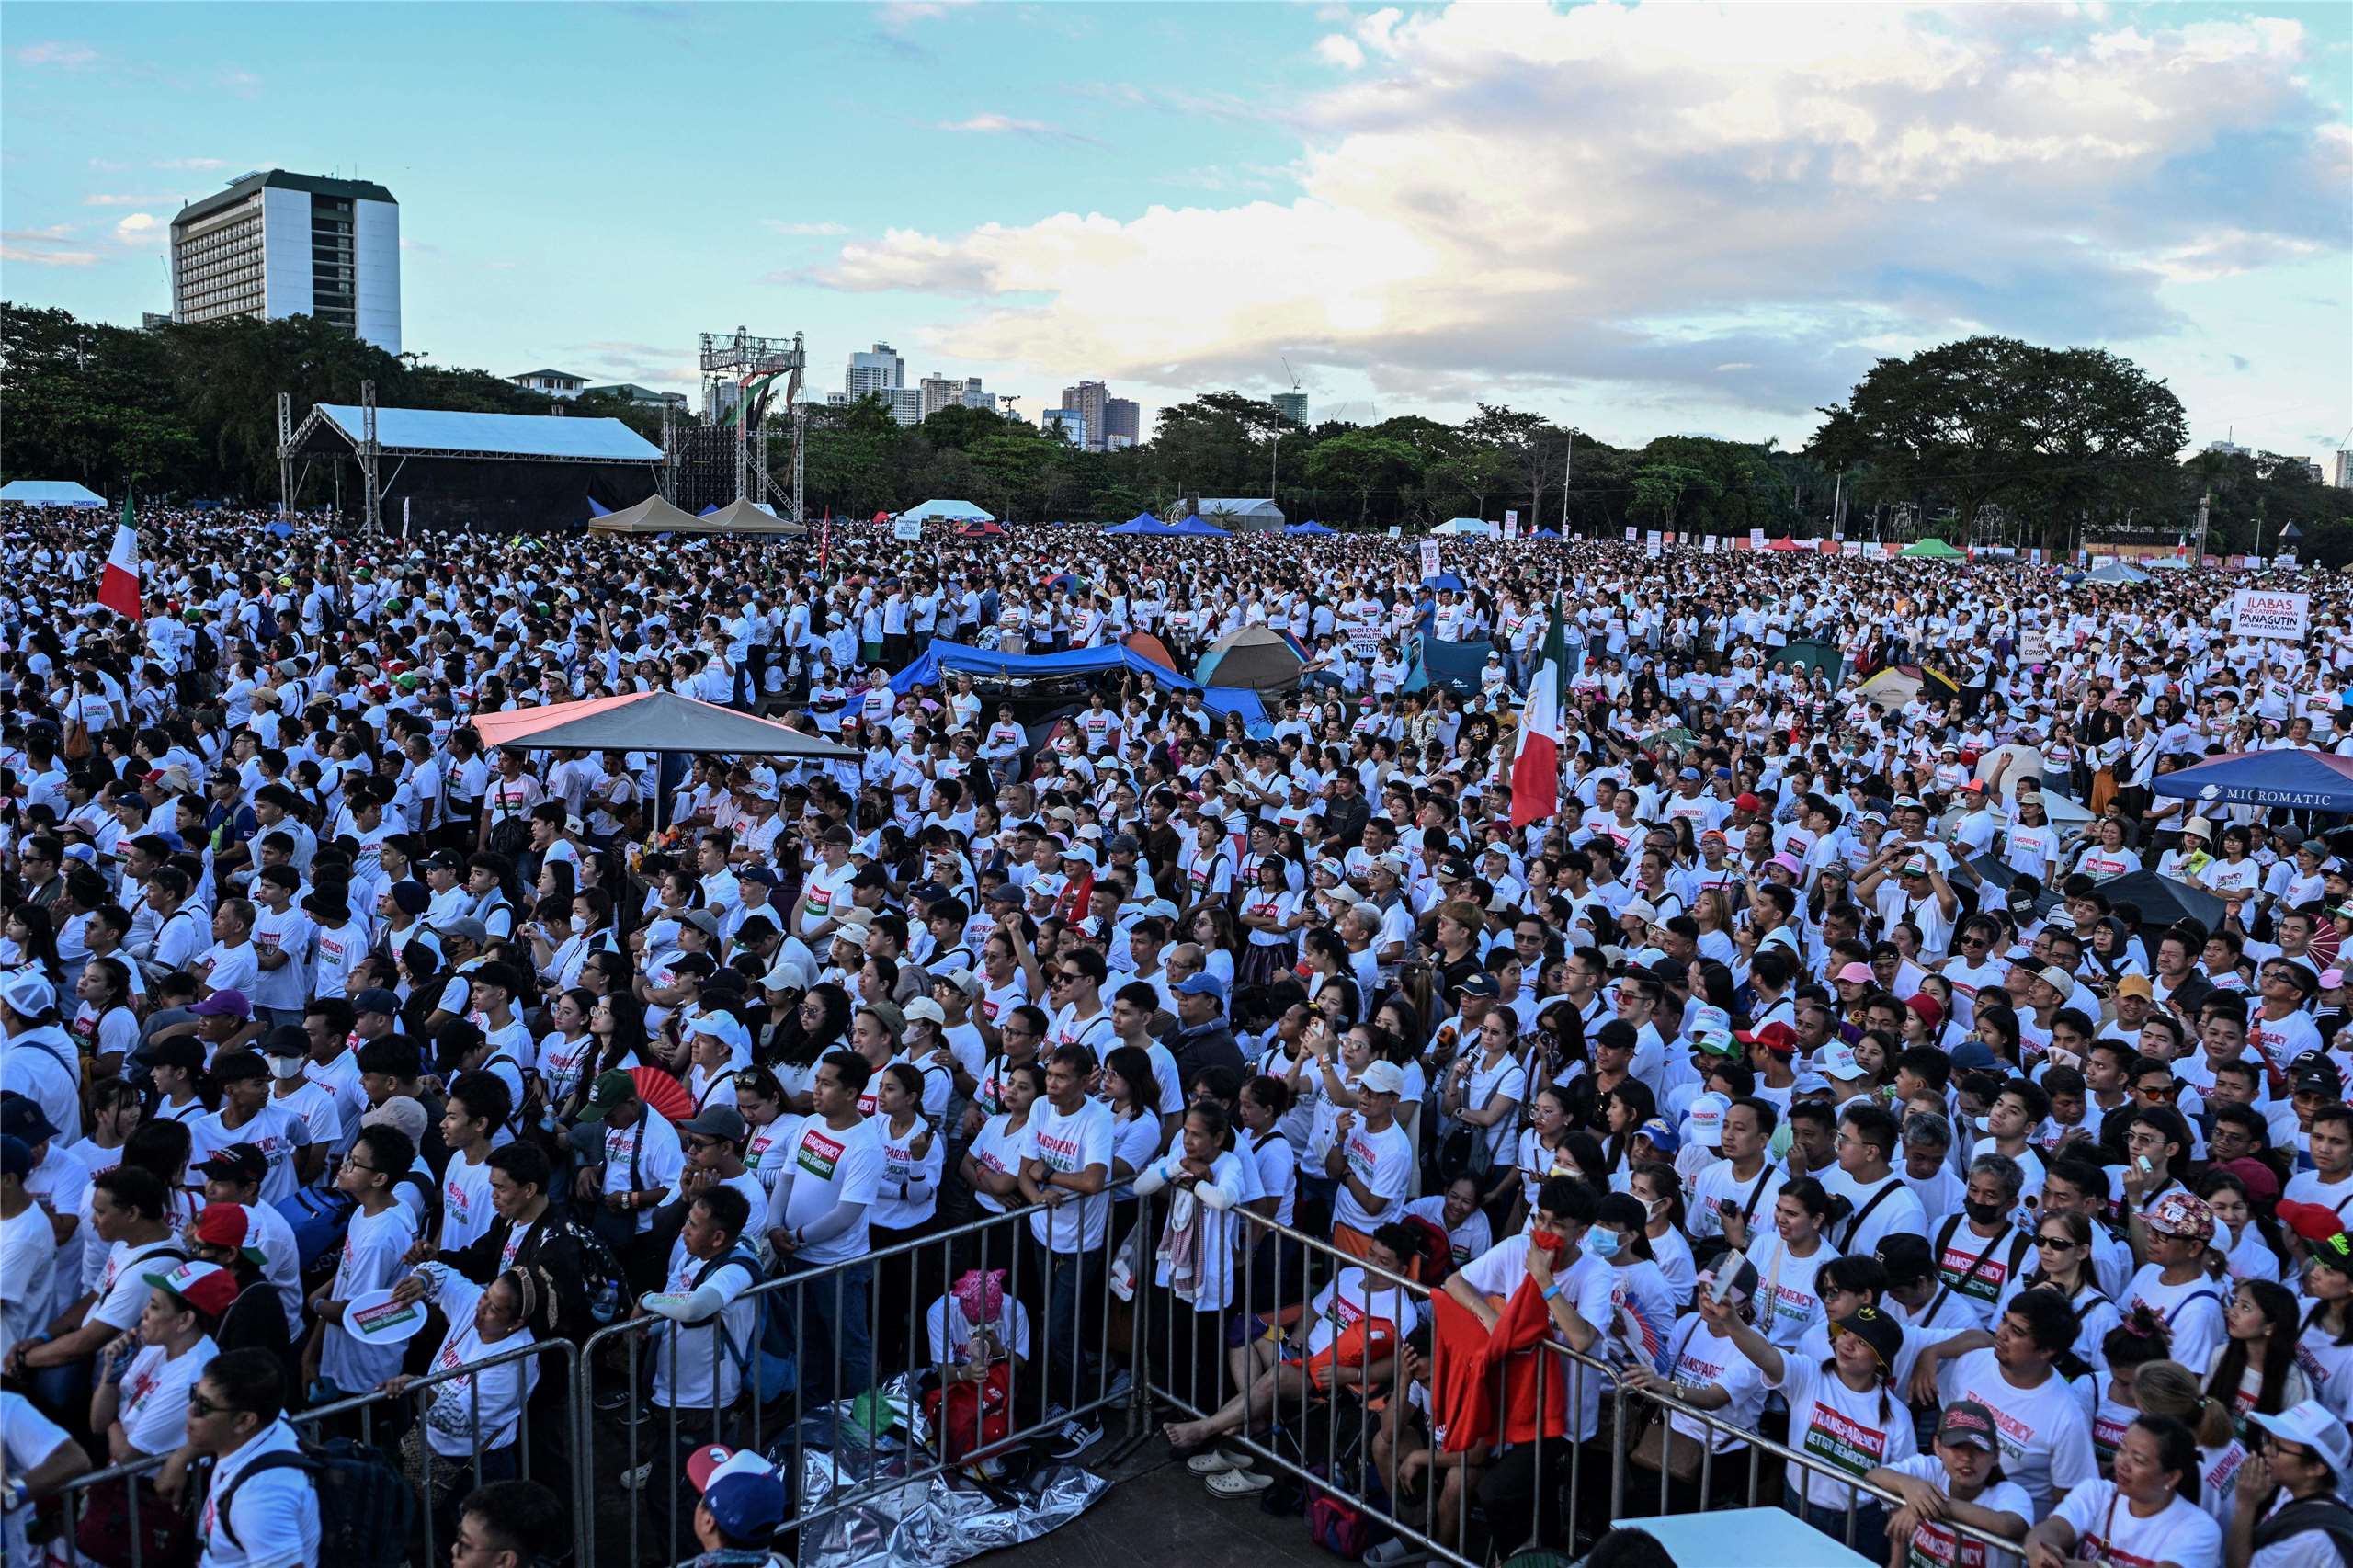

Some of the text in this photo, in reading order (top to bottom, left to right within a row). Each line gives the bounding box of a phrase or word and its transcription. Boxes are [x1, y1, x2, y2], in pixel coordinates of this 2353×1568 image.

[2247, 597, 2292, 610] ILABAS
[2239, 613, 2297, 625] PANAGUTIN
[2227, 789, 2331, 805] MICROMATIC
[1813, 1409, 1883, 1454] TRANSPARENCY
[1807, 1432, 1835, 1452] BETTER
